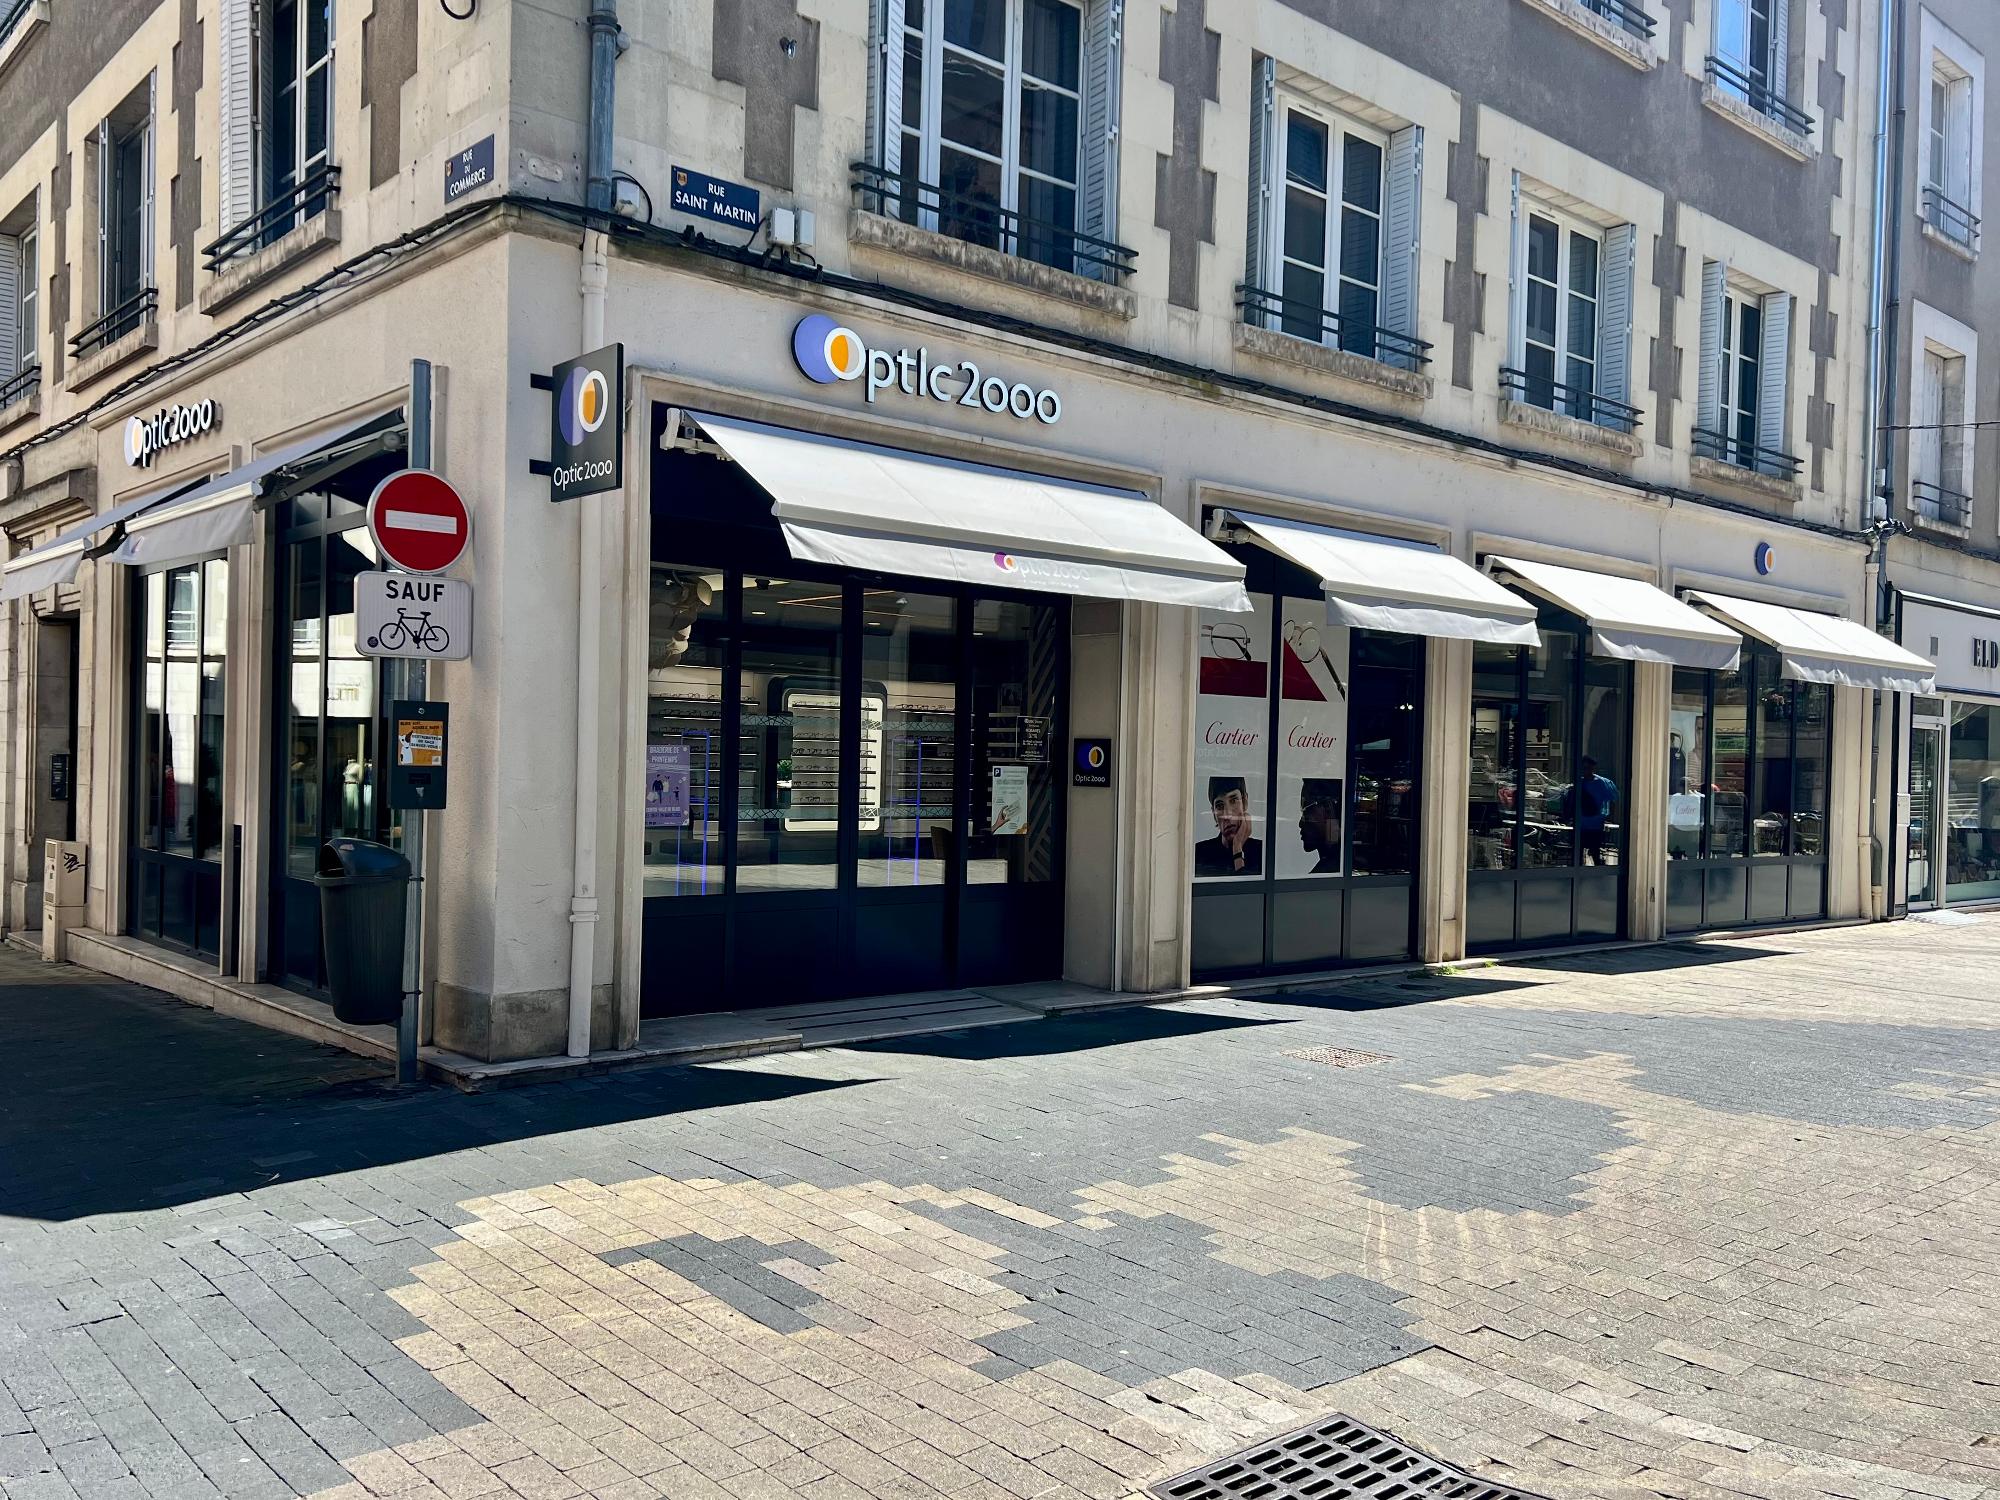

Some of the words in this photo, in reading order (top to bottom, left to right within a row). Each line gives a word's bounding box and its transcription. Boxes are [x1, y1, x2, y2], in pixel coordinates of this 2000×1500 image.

[462, 148, 473, 164] RUE
[464, 163, 471, 174] DU
[449, 166, 486, 197] COMMERCE
[708, 182, 725, 198] RUE
[675, 190, 708, 211] SAINT
[713, 201, 756, 225] MARTIN
[824, 326, 952, 403] Optic
[957, 361, 1062, 424] 2000
[171, 398, 213, 443] 2000
[553, 462, 583, 491] Optic
[584, 459, 613, 480] 2000
[385, 579, 445, 603] SAUF
[1205, 720, 1259, 746] Cartier
[1288, 724, 1337, 749] Cartier
